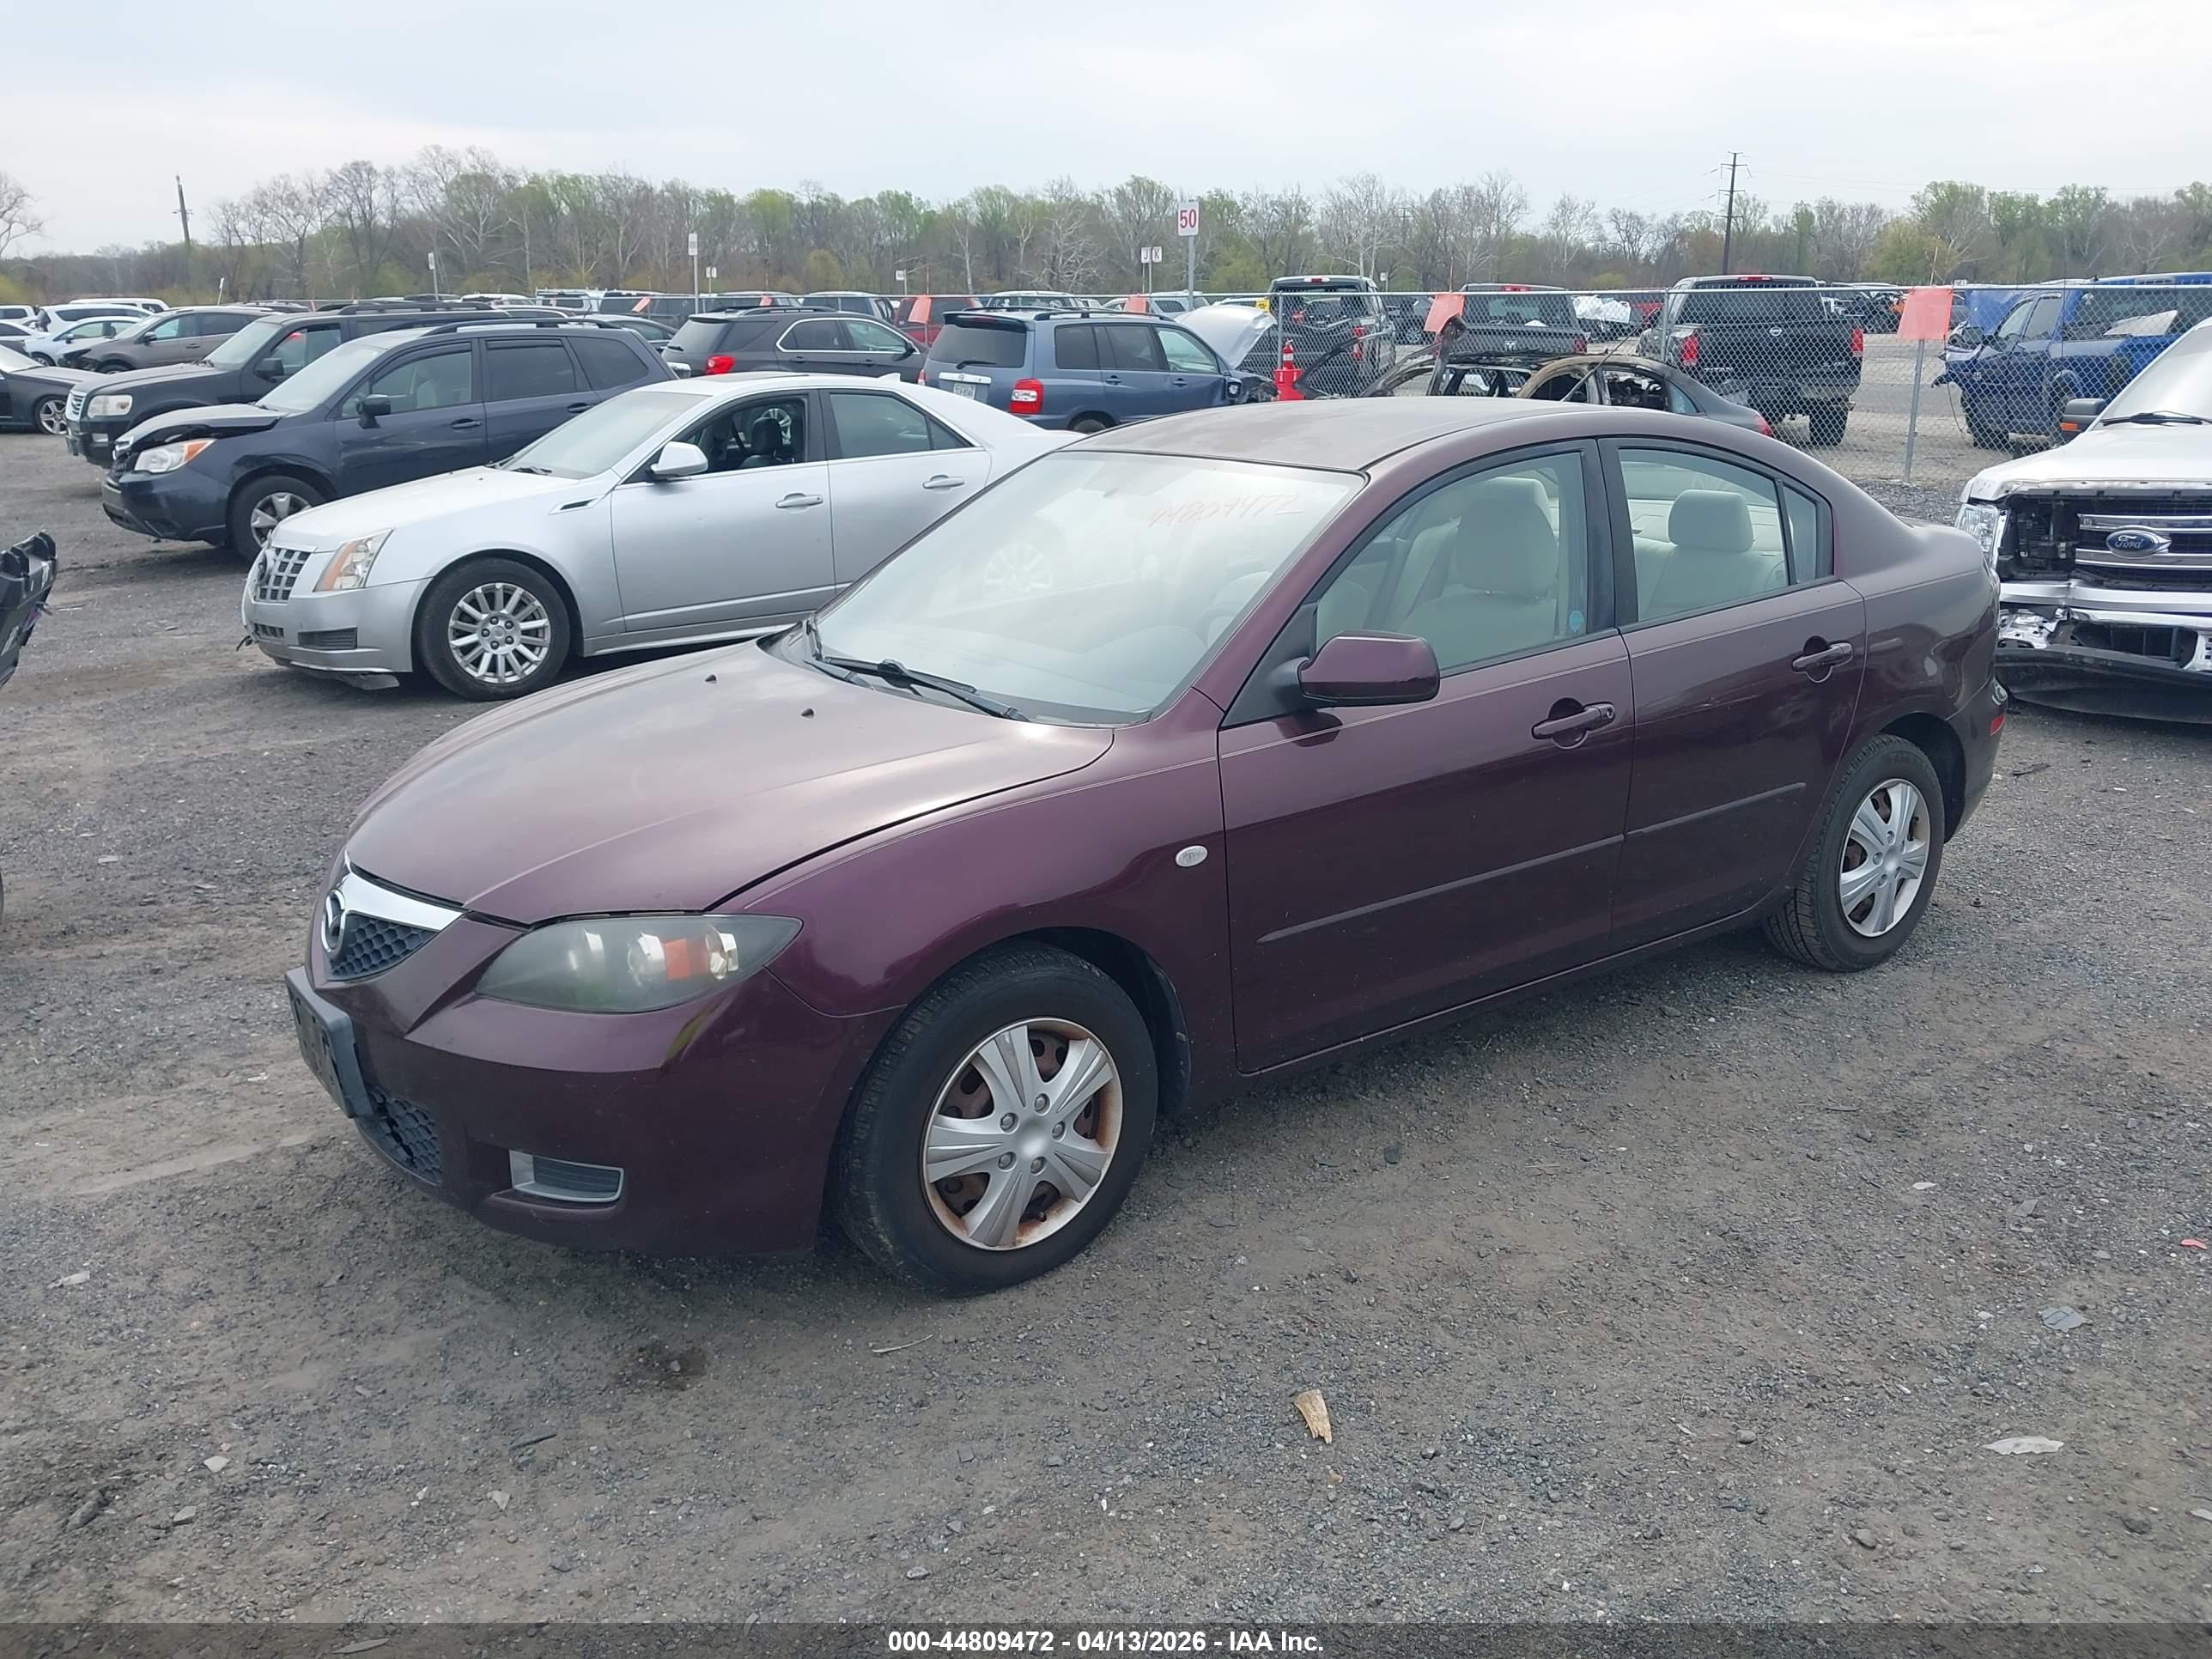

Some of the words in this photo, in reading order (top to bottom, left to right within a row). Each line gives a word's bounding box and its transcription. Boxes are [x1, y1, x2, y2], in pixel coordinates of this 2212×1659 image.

[1180, 209, 1197, 229] 50
[1143, 249, 1149, 261] J
[1154, 248, 1160, 260] K
[2115, 535, 2144, 550] Ford
